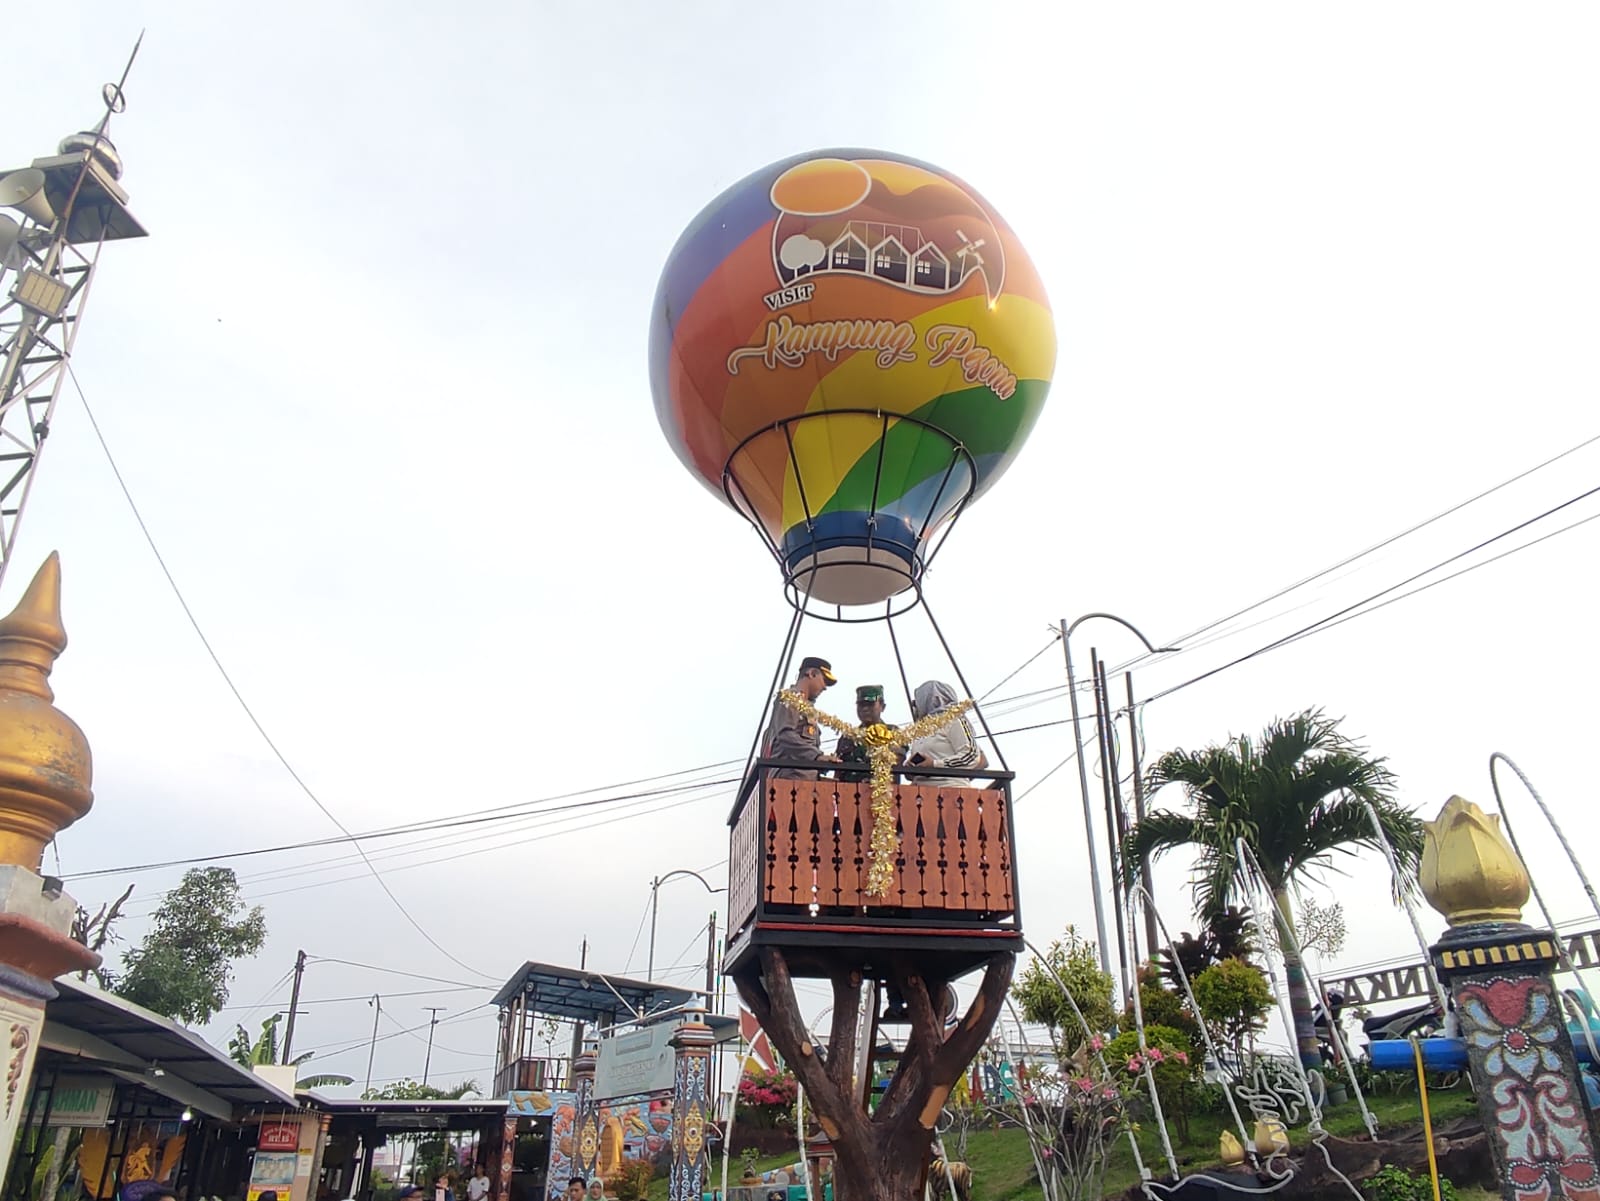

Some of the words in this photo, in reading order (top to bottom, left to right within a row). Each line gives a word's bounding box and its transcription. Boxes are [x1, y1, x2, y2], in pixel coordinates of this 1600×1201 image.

[764, 283, 814, 310] VISIT
[728, 316, 917, 375] Kampung
[926, 325, 1016, 400] Pesona
